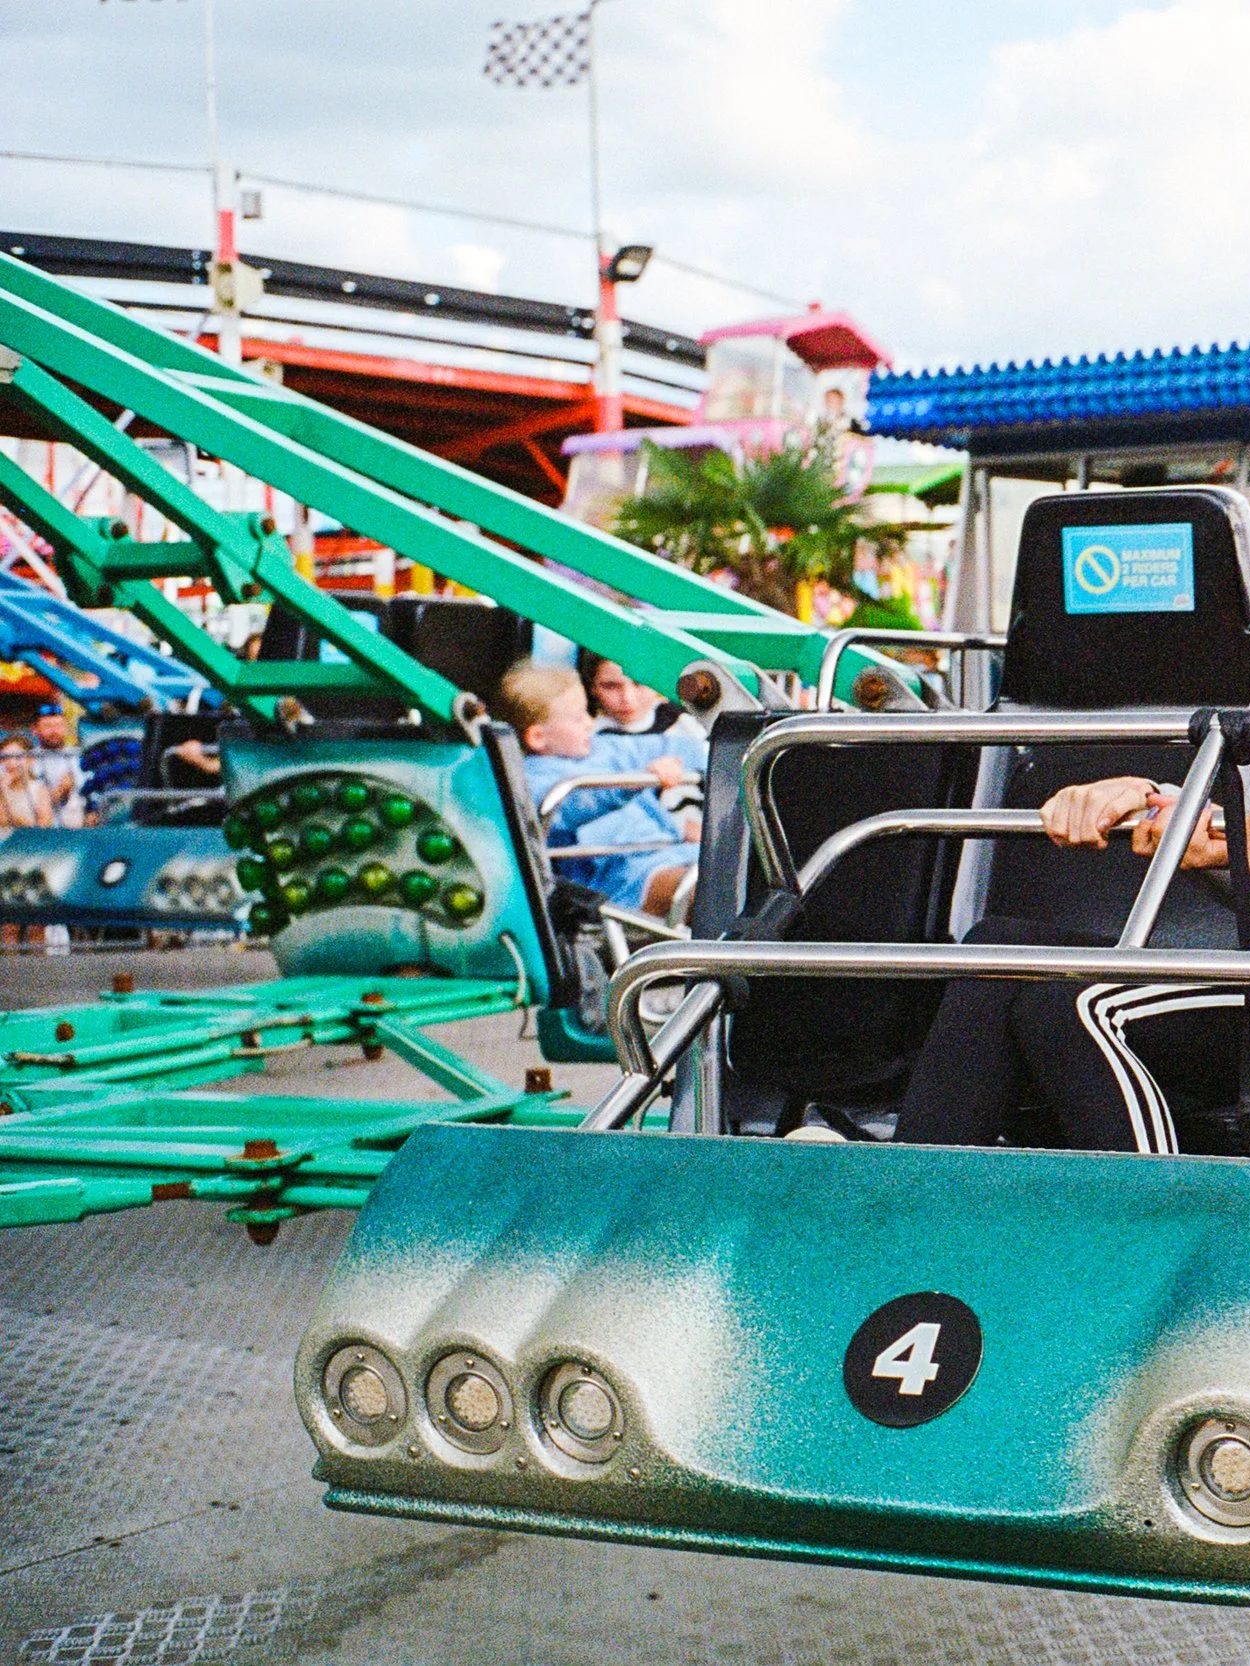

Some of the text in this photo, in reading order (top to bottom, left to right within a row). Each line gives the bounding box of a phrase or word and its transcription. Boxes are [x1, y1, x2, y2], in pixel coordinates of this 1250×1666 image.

[1121, 548, 1181, 562] MAXIMUM
[1121, 562, 1178, 574] 2 RIDERS
[1122, 575, 1177, 588] PER CAR
[871, 1322, 941, 1395] 4
